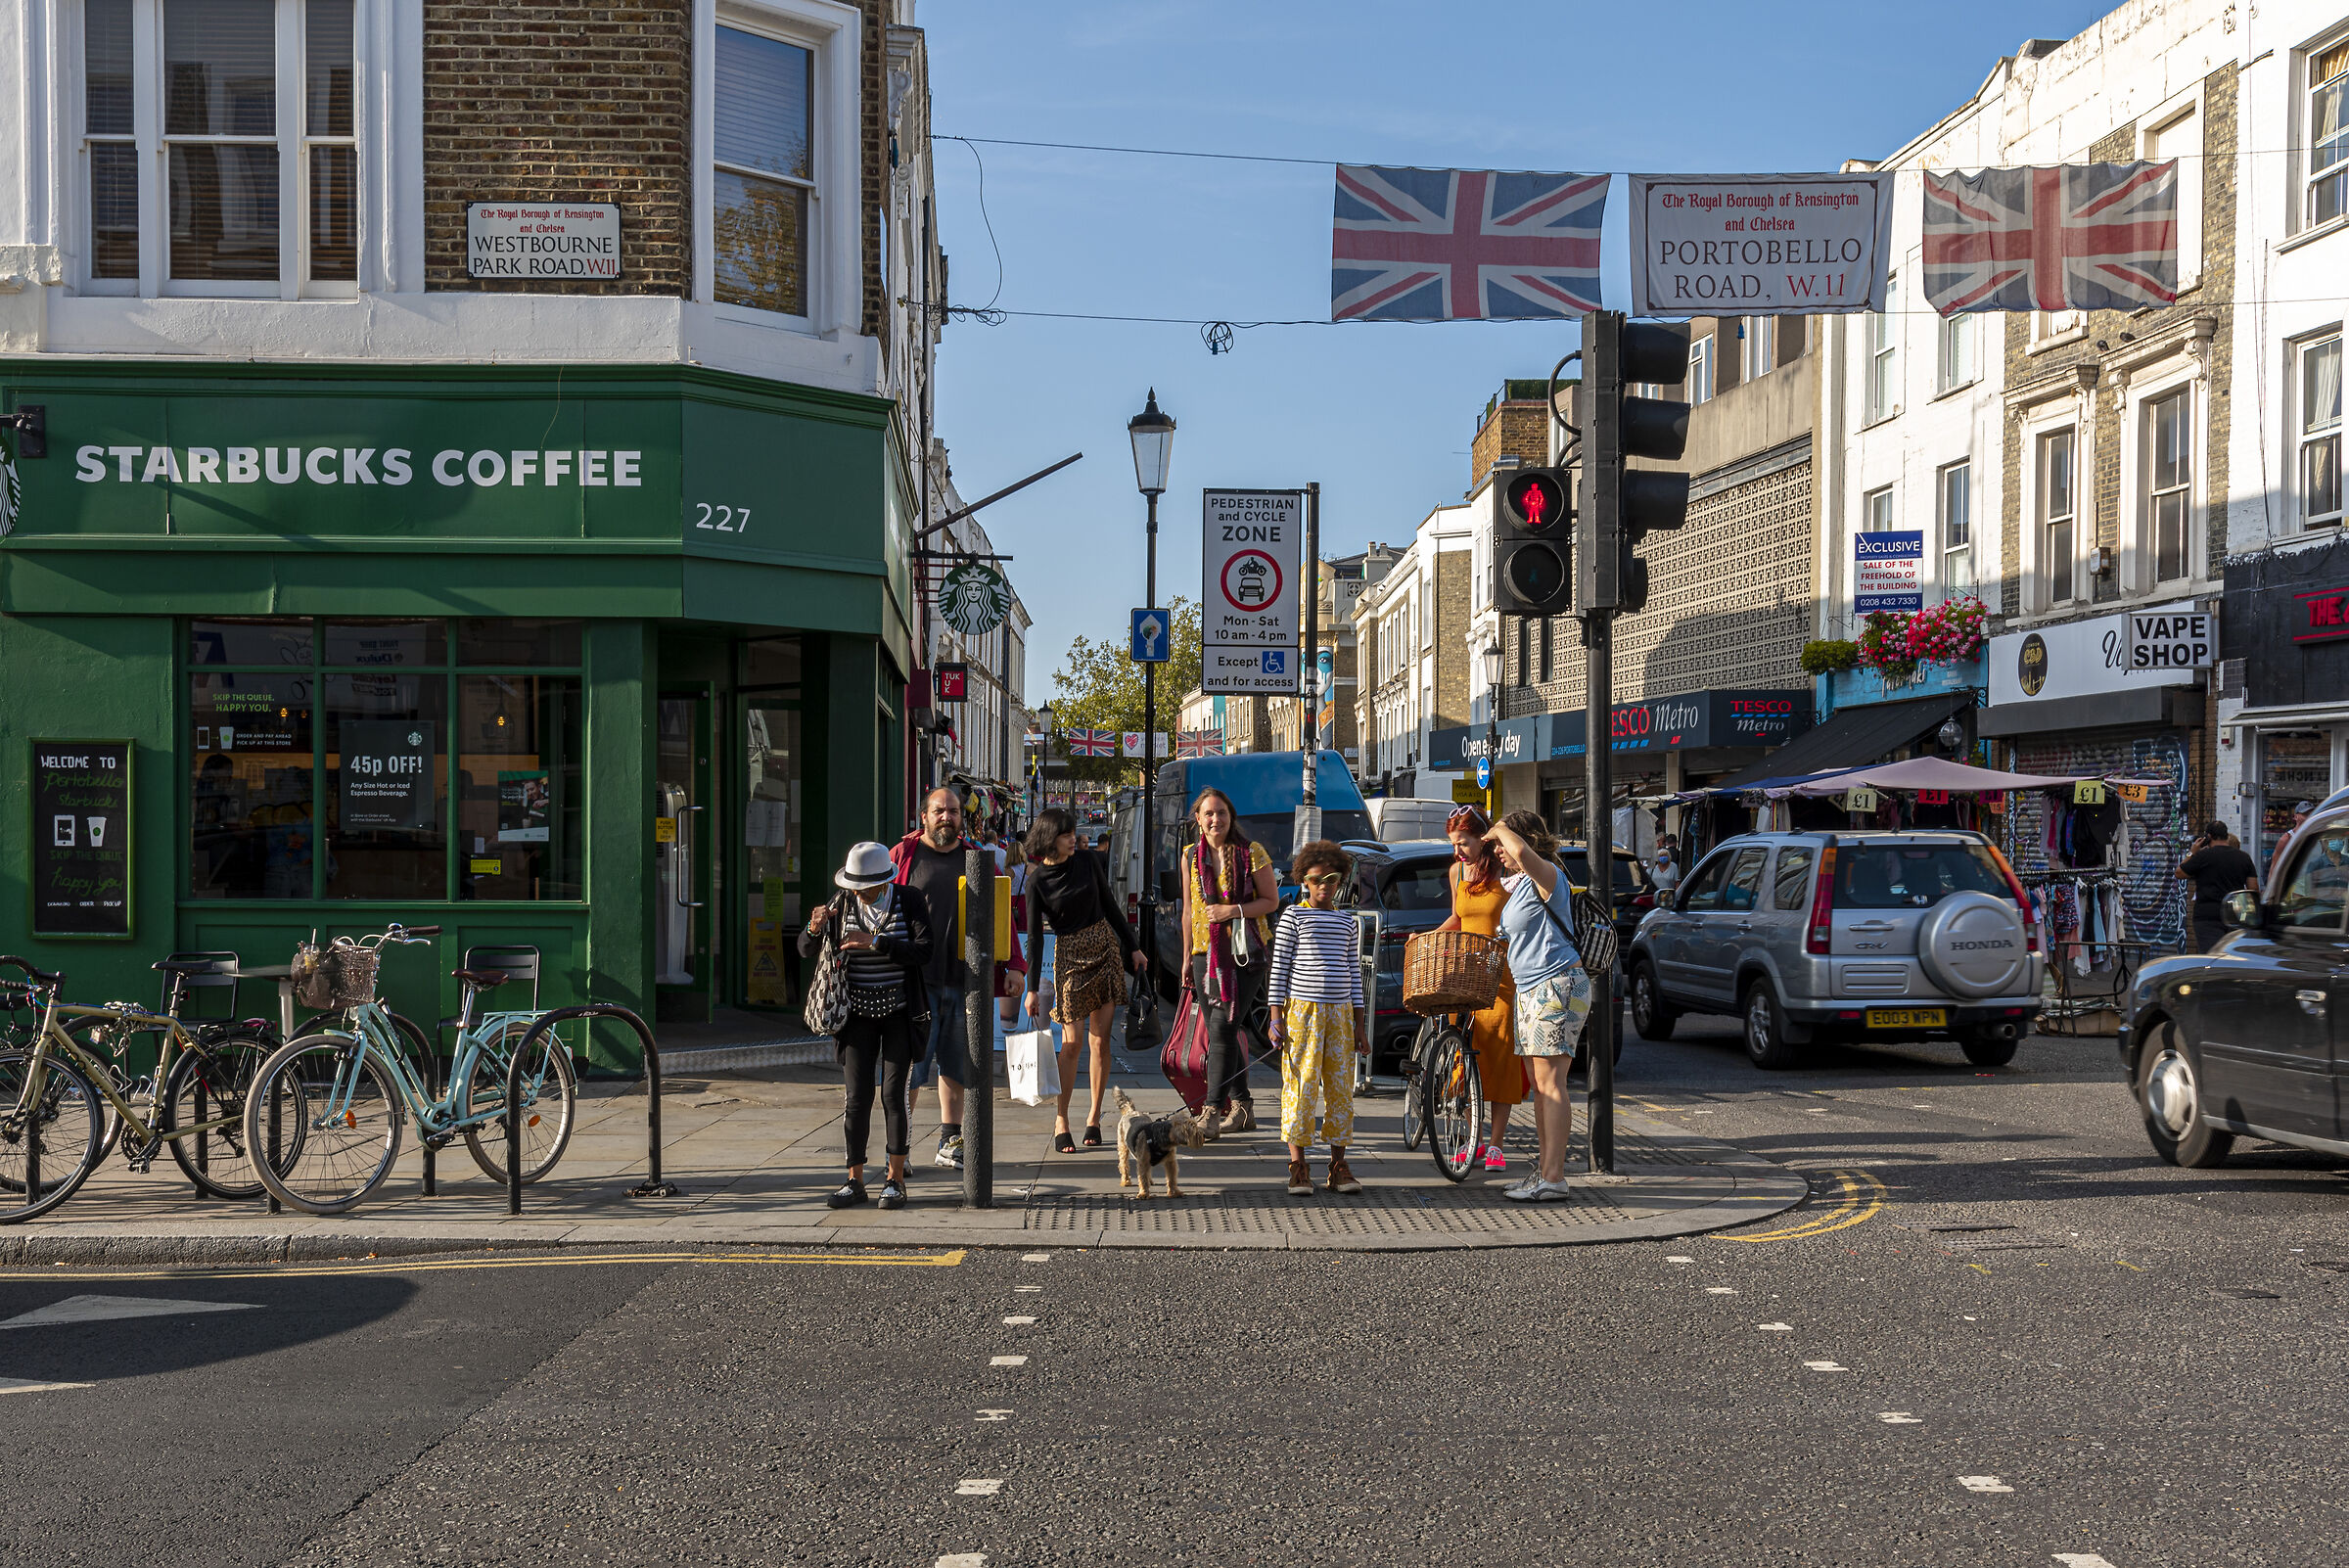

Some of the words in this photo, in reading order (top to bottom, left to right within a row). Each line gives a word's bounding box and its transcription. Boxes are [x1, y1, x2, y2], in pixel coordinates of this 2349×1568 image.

[1662, 194, 1684, 208] The
[1690, 193, 1723, 211] Royal
[1727, 193, 1773, 211] Borough
[1778, 193, 1792, 207] of
[1795, 192, 1859, 210] Kensington
[481, 208, 495, 218] The
[497, 208, 518, 220] Royal
[521, 208, 550, 220] Borough
[554, 208, 562, 218] of
[565, 208, 604, 220] Kensington
[520, 224, 532, 233] and
[536, 223, 565, 233] Chelsea
[1725, 217, 1744, 232] and
[1750, 216, 1795, 232] Chelsea
[475, 236, 613, 254] WESTBOURNE
[1660, 238, 1862, 265] PORTOBELLO
[473, 257, 522, 274] PARK
[1674, 274, 1772, 304] ROAD,
[1786, 273, 1845, 297] W.11
[74, 445, 413, 486] STARBUCKS
[432, 449, 642, 487] COFFEE
[1211, 498, 1294, 509] PEDESTRIAN
[696, 503, 751, 533] 227
[1219, 512, 1239, 521] and
[1244, 512, 1286, 522] CYCLE
[1221, 526, 1281, 542] ZONE
[1858, 540, 1919, 554] EXCLUSIVE
[1877, 581, 1916, 590] BUILDING
[2306, 596, 2343, 626] THE
[1223, 616, 1249, 626] Mon
[1258, 616, 1279, 626] Sat
[2136, 617, 2205, 639] VAPE
[1215, 629, 1229, 639] 10
[1258, 630, 1267, 640] 4
[1268, 632, 1287, 643] pm
[2134, 643, 2208, 667] SHOP
[1218, 657, 1259, 668] Except
[1207, 676, 1229, 686] and
[1232, 676, 1250, 685] for
[1254, 678, 1293, 687] access
[249, 704, 271, 713] YOU.
[1730, 700, 1792, 713] TESCO
[1612, 708, 1650, 736] ESCO
[1655, 702, 1698, 732] Metro
[1736, 719, 1785, 731] Metro
[1461, 736, 1481, 761] Open
[1505, 729, 1520, 758] day
[41, 755, 89, 768] WELCOME
[99, 757, 116, 769] TO
[350, 756, 383, 776] 45p
[388, 755, 423, 773] OFF!
[2078, 786, 2097, 803] £1
[2125, 785, 2140, 798] £3
[1854, 794, 1870, 809] £1
[1951, 940, 2013, 951] HONDA
[1912, 1011, 1940, 1024] WPN
